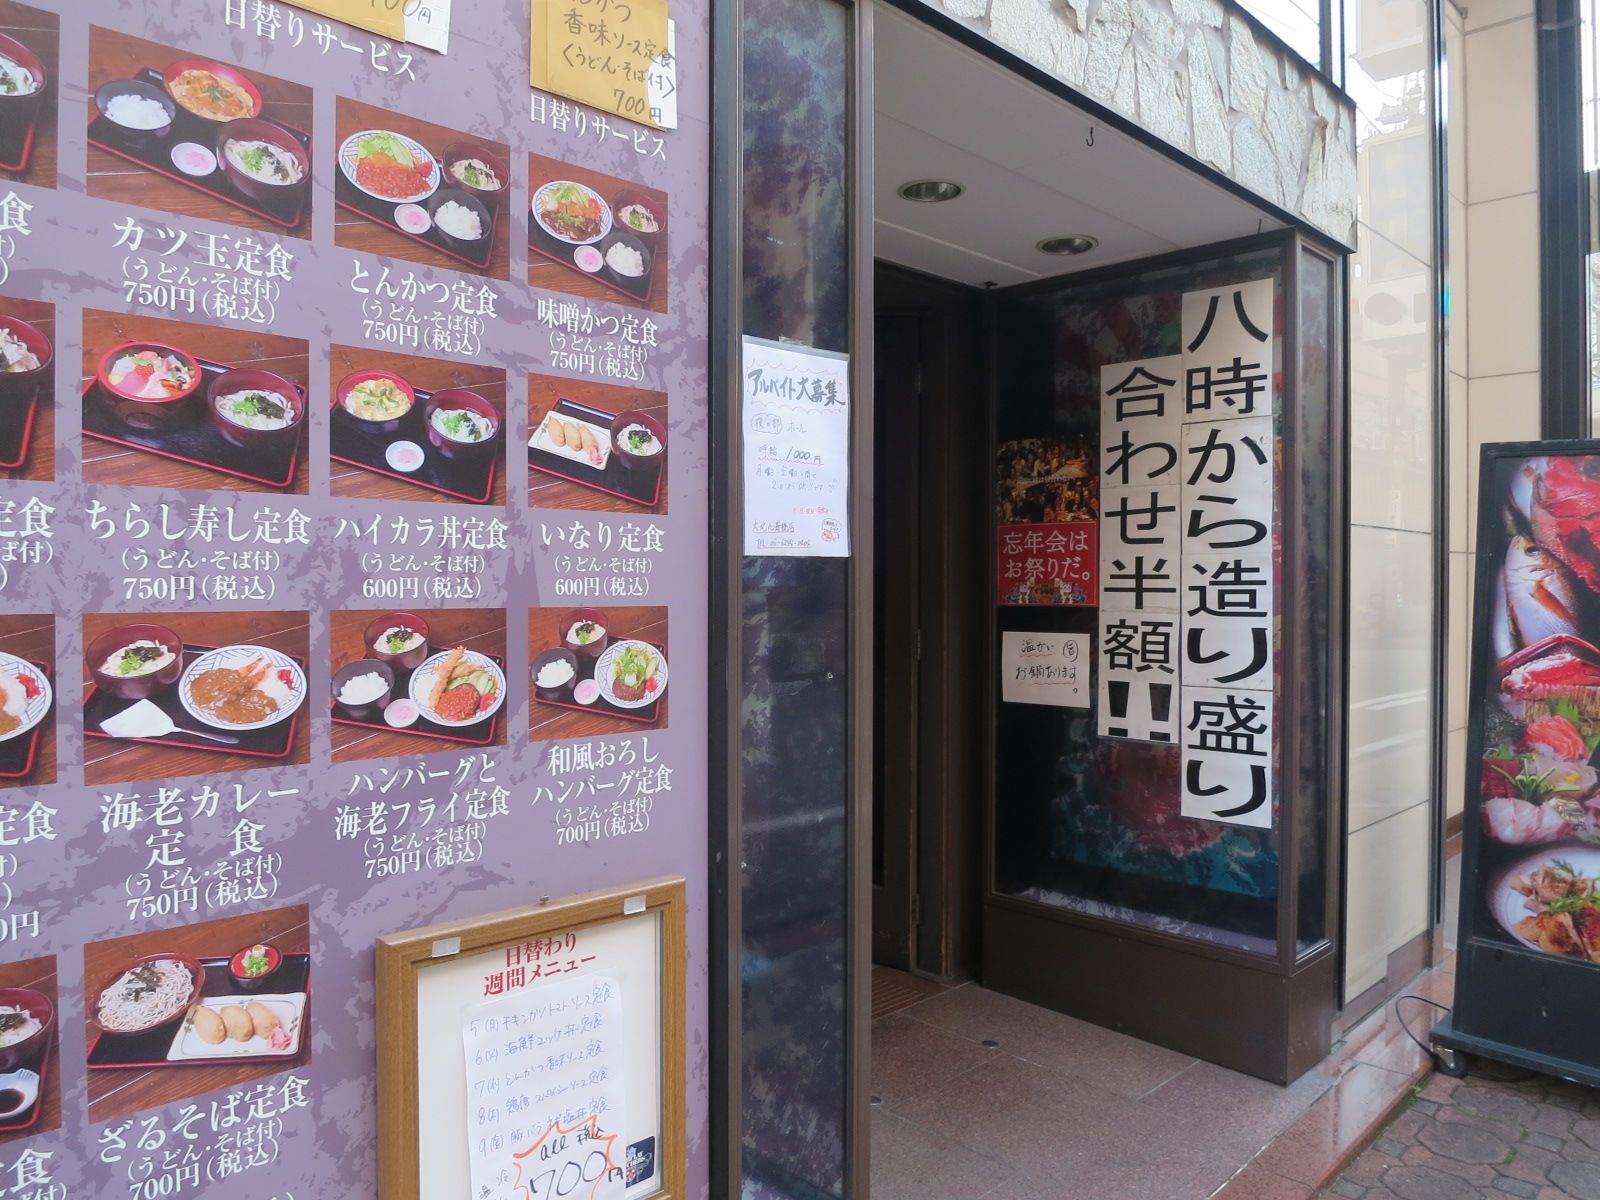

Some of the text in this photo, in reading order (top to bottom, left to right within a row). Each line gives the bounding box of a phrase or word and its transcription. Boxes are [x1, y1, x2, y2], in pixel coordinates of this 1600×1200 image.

[224, 0, 415, 81] 日替りサービス
[563, 7, 676, 70] 香味ソース定食
[530, 92, 667, 162] 日替りサービス
[613, 88, 662, 123] 700円
[112, 216, 295, 282] カツ玉定食
[349, 259, 499, 320] とんかつ定食
[536, 298, 660, 349] 味噌かつ定食
[747, 368, 846, 407] アルバイト大募集
[85, 498, 313, 546] ちらし寿し定食
[334, 513, 509, 551] ハイカラ丼定食
[541, 520, 666, 554] いなり定食
[1003, 530, 1089, 556] 忘年会は
[1004, 556, 1091, 582] お祭りだ。
[1185, 289, 1270, 818] 八時から造り盛り
[347, 753, 497, 796] ハンバーグと
[547, 737, 660, 777] 和風おろし
[531, 763, 674, 807] ハンバーグ定食
[100, 783, 300, 834] 海老カレー
[334, 785, 511, 842] 海老フライ定食
[505, 932, 577, 968] 日替わり
[483, 954, 597, 998] 週間メニュー
[98, 1075, 311, 1164] ざるそば定食
